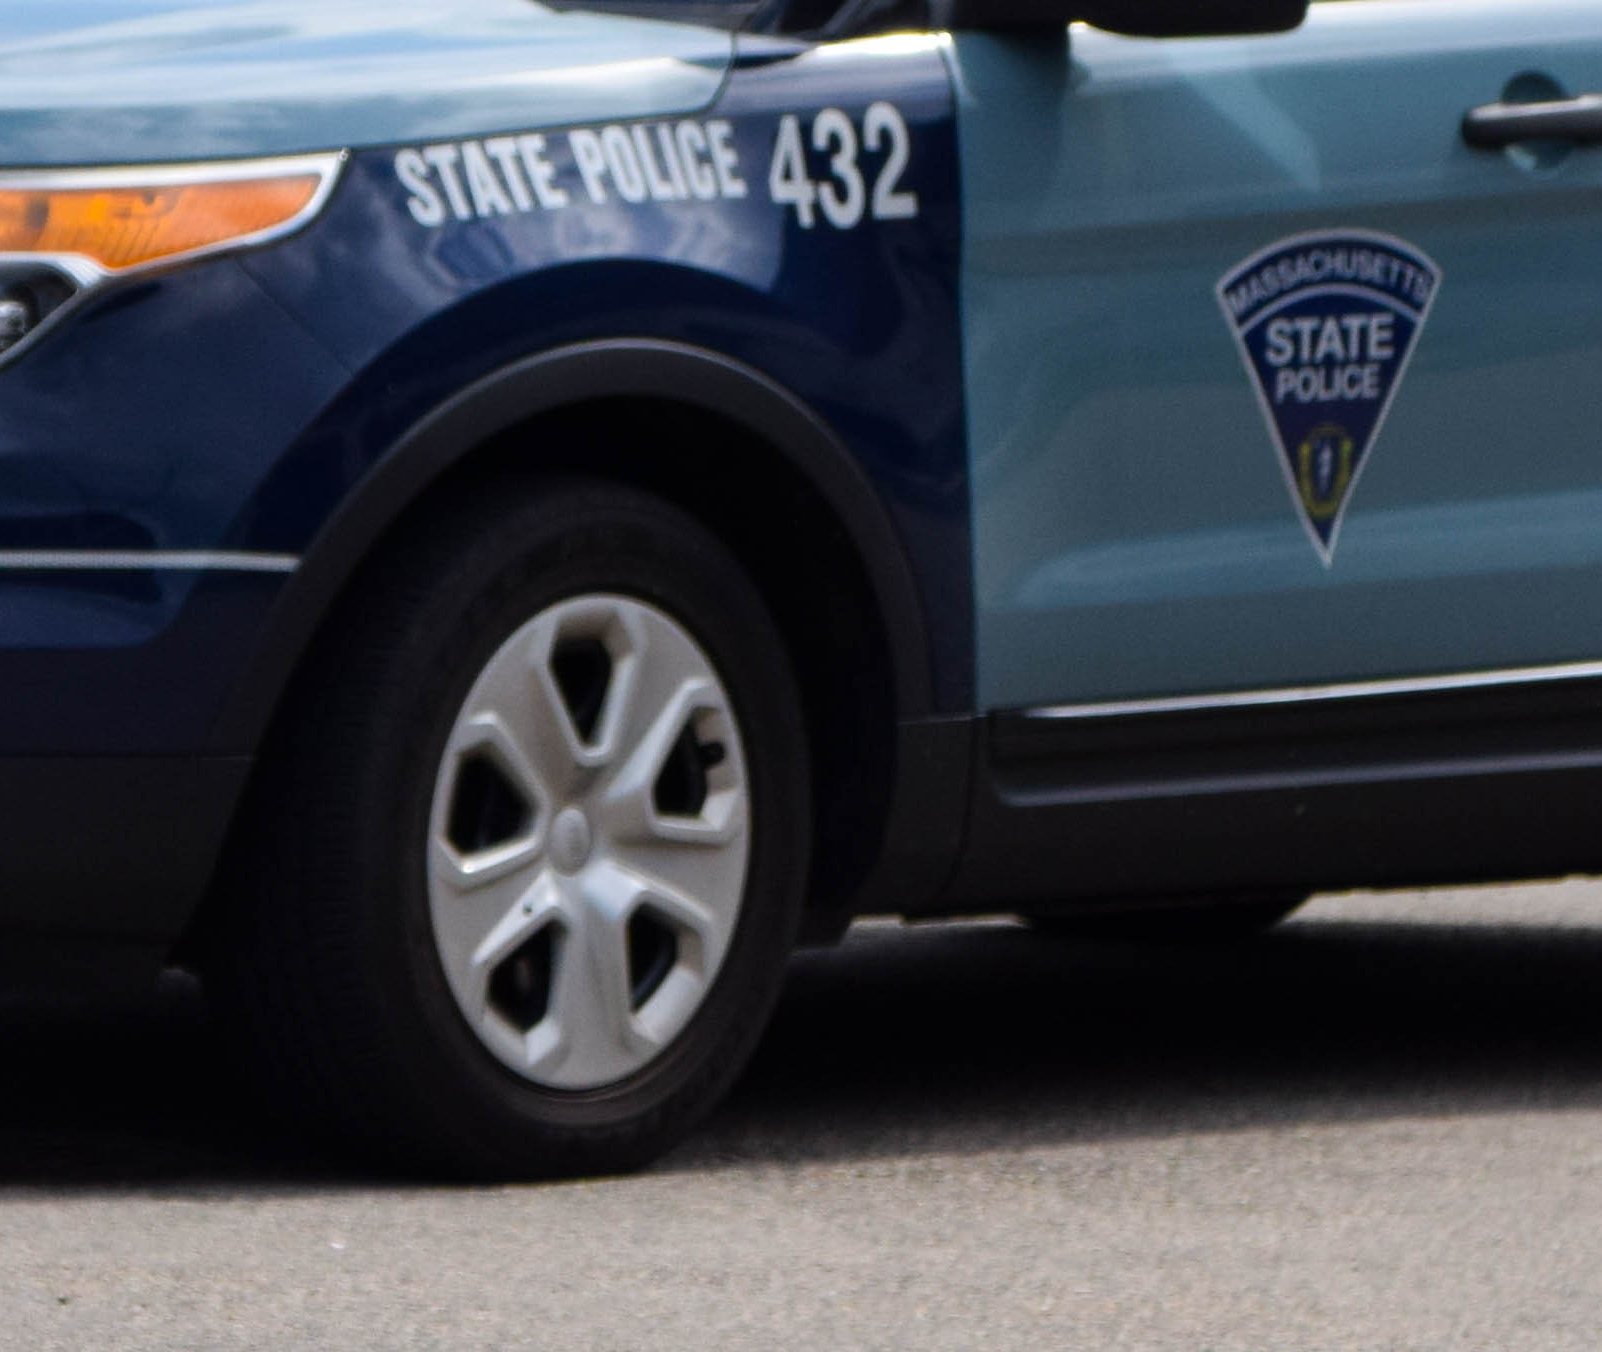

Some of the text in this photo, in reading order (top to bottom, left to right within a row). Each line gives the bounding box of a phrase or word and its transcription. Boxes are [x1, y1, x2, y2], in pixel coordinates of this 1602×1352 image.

[394, 101, 919, 230] STATE POLICE 432
[1227, 248, 1430, 315] MASSACHUSETTS
[1266, 314, 1394, 365] STATE
[1278, 366, 1380, 402] POLICE
